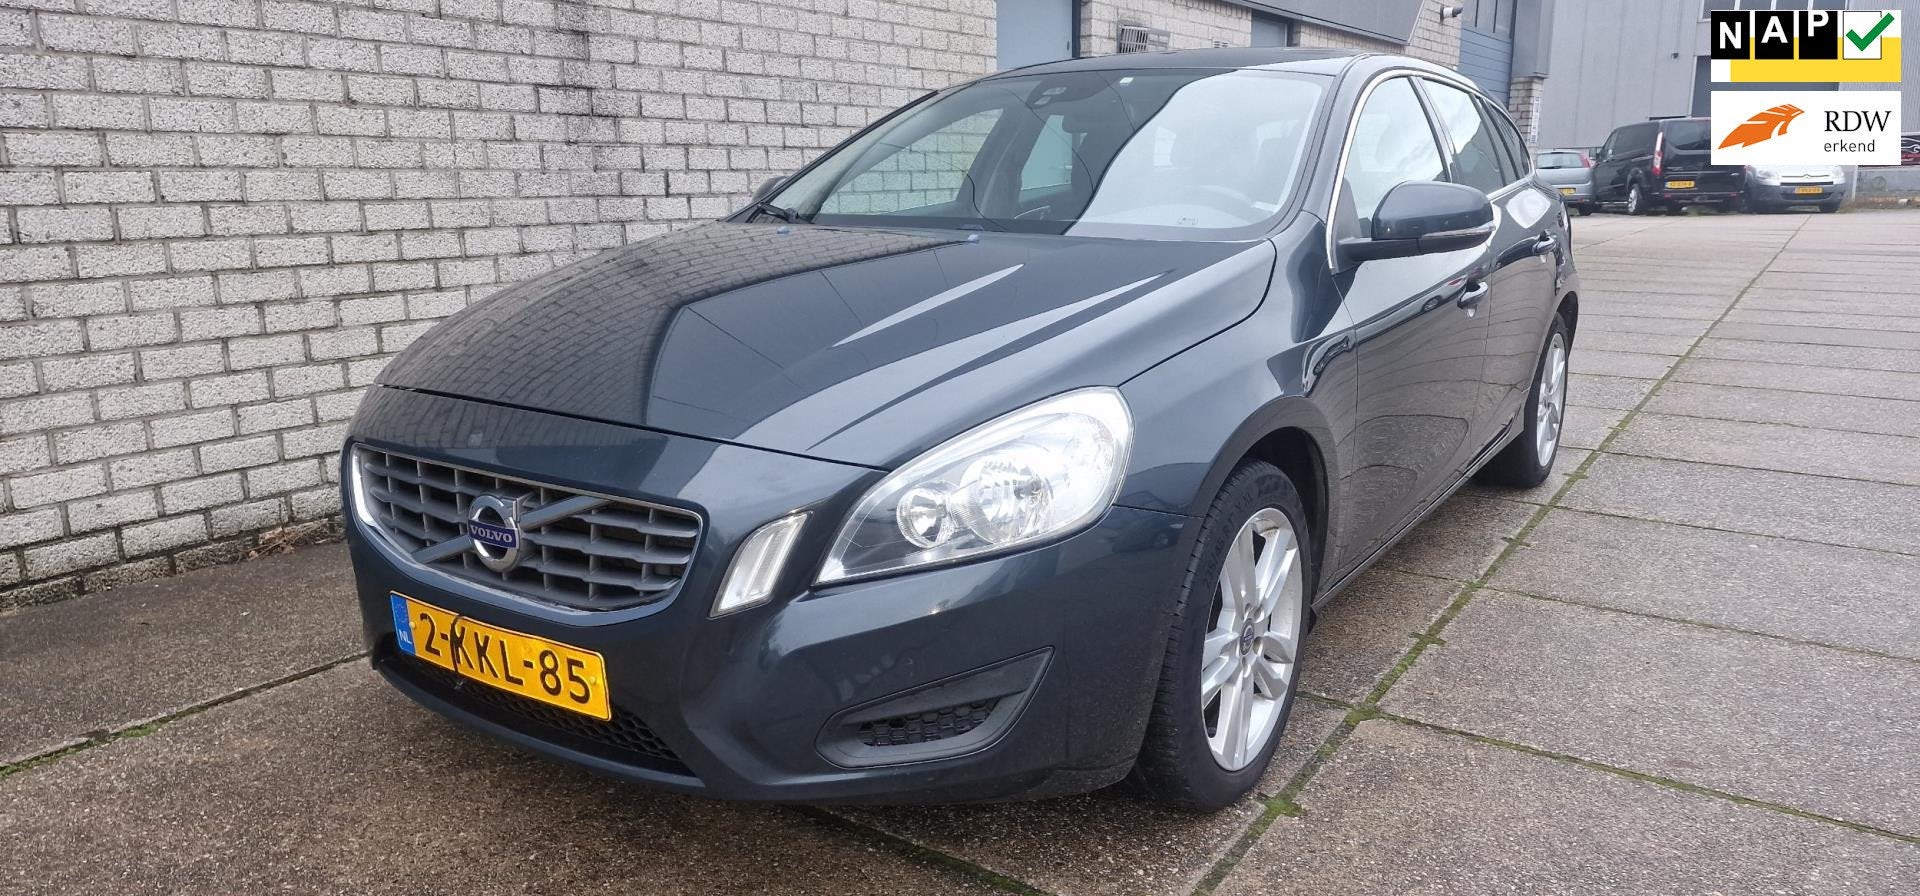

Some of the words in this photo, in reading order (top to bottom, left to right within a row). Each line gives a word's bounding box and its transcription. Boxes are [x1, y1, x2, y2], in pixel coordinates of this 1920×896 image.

[470, 524, 513, 543] VOLVO
[399, 629, 412, 644] NL
[419, 612, 591, 704] 2-KKL-85
